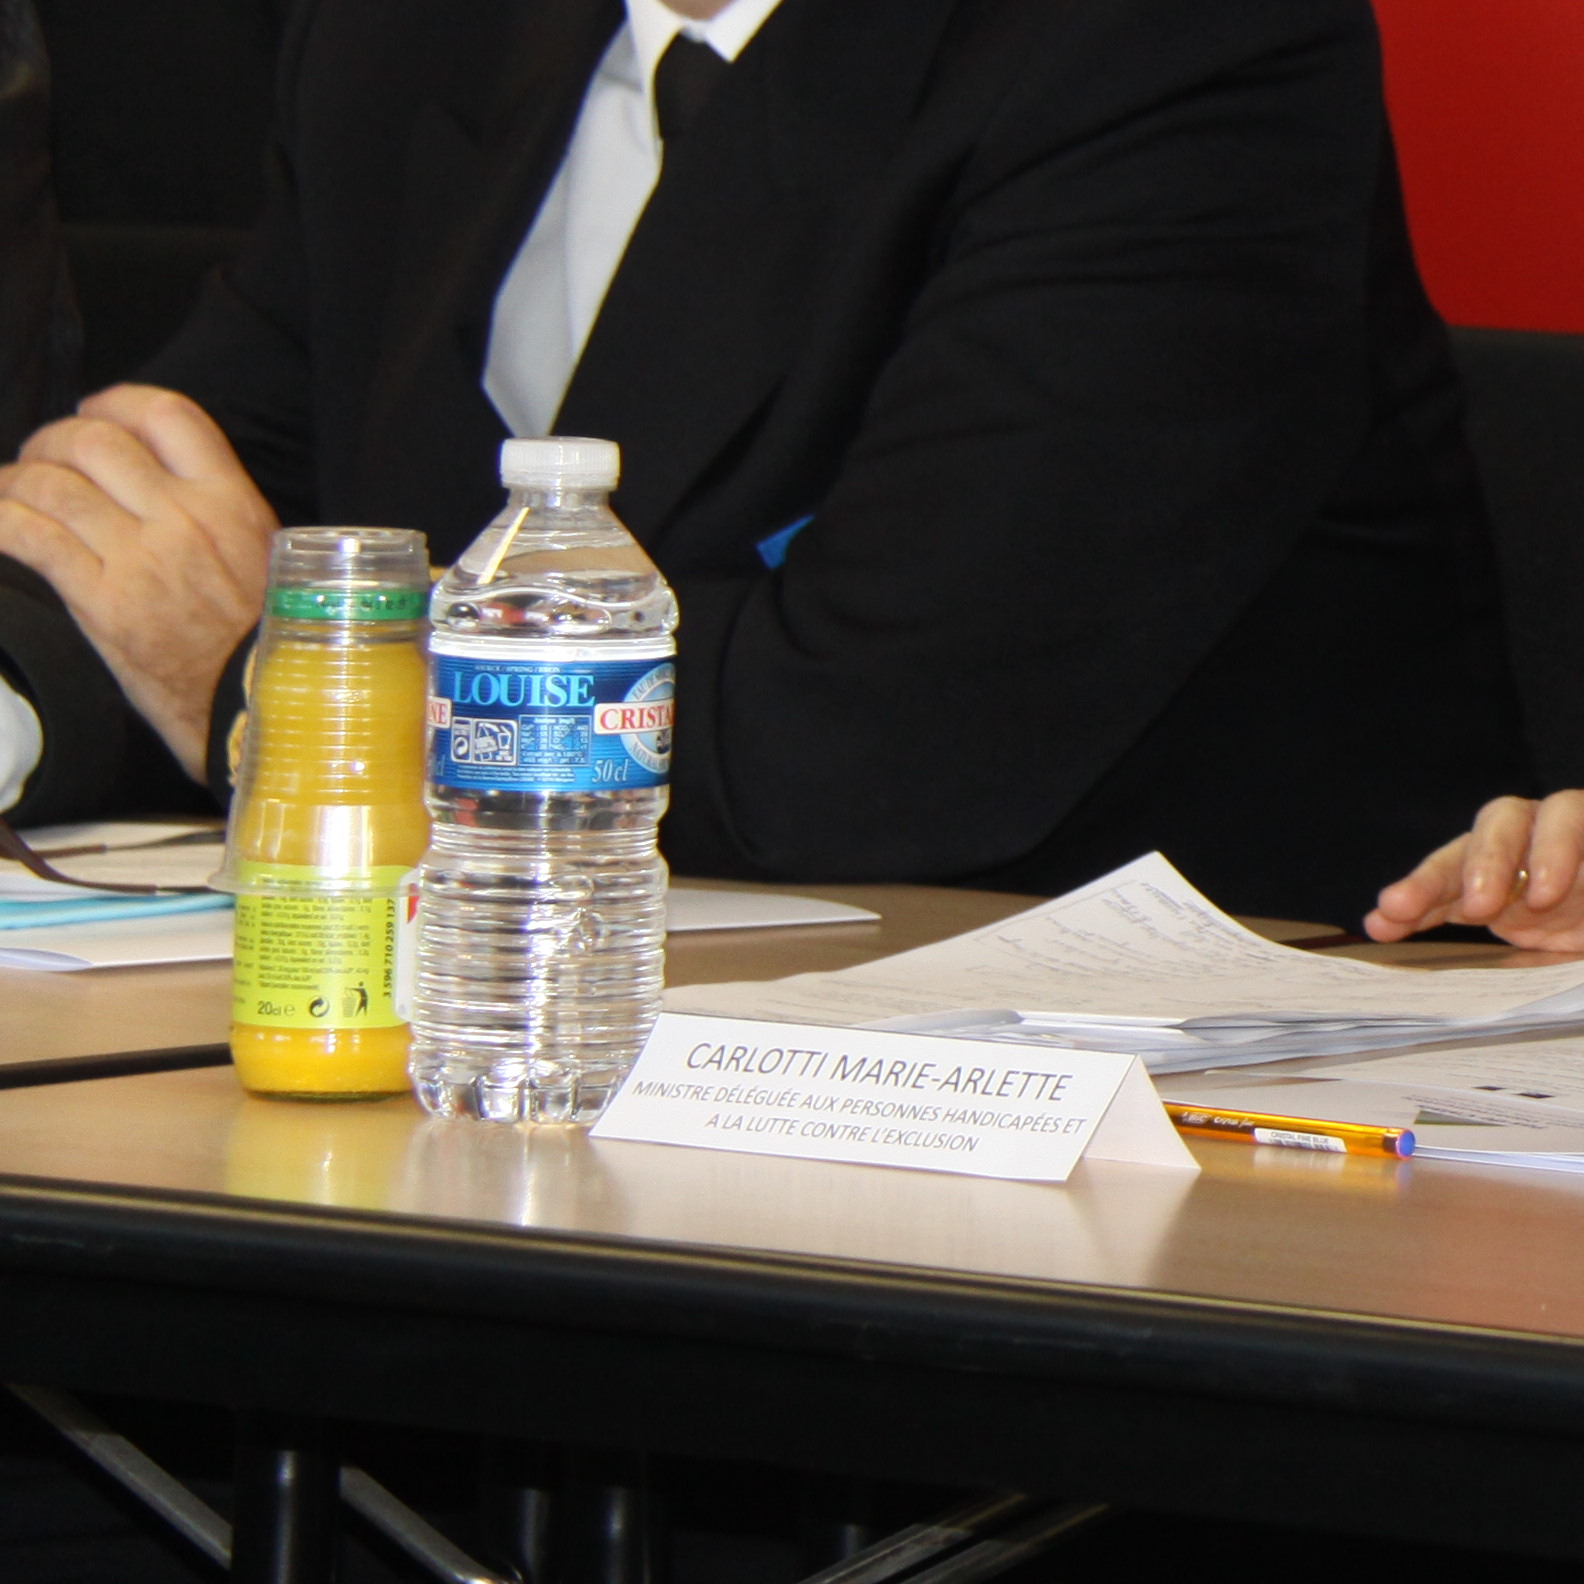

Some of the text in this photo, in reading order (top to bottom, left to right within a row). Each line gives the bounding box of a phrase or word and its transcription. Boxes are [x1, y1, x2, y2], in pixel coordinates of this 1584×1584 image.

[453, 671, 596, 708] LOUISE
[386, 898, 395, 918] 137
[384, 945, 394, 966] 710
[686, 1042, 1073, 1101] CARLOTTI MARIE-ARLETTE
[632, 1080, 1086, 1135] MINISTRE DÉLÉGUÉE AUX PERSONNES HANDICAPÉES ET
[705, 1113, 980, 1152] A LA LUTTE CONTRE L'EXCLUSION
